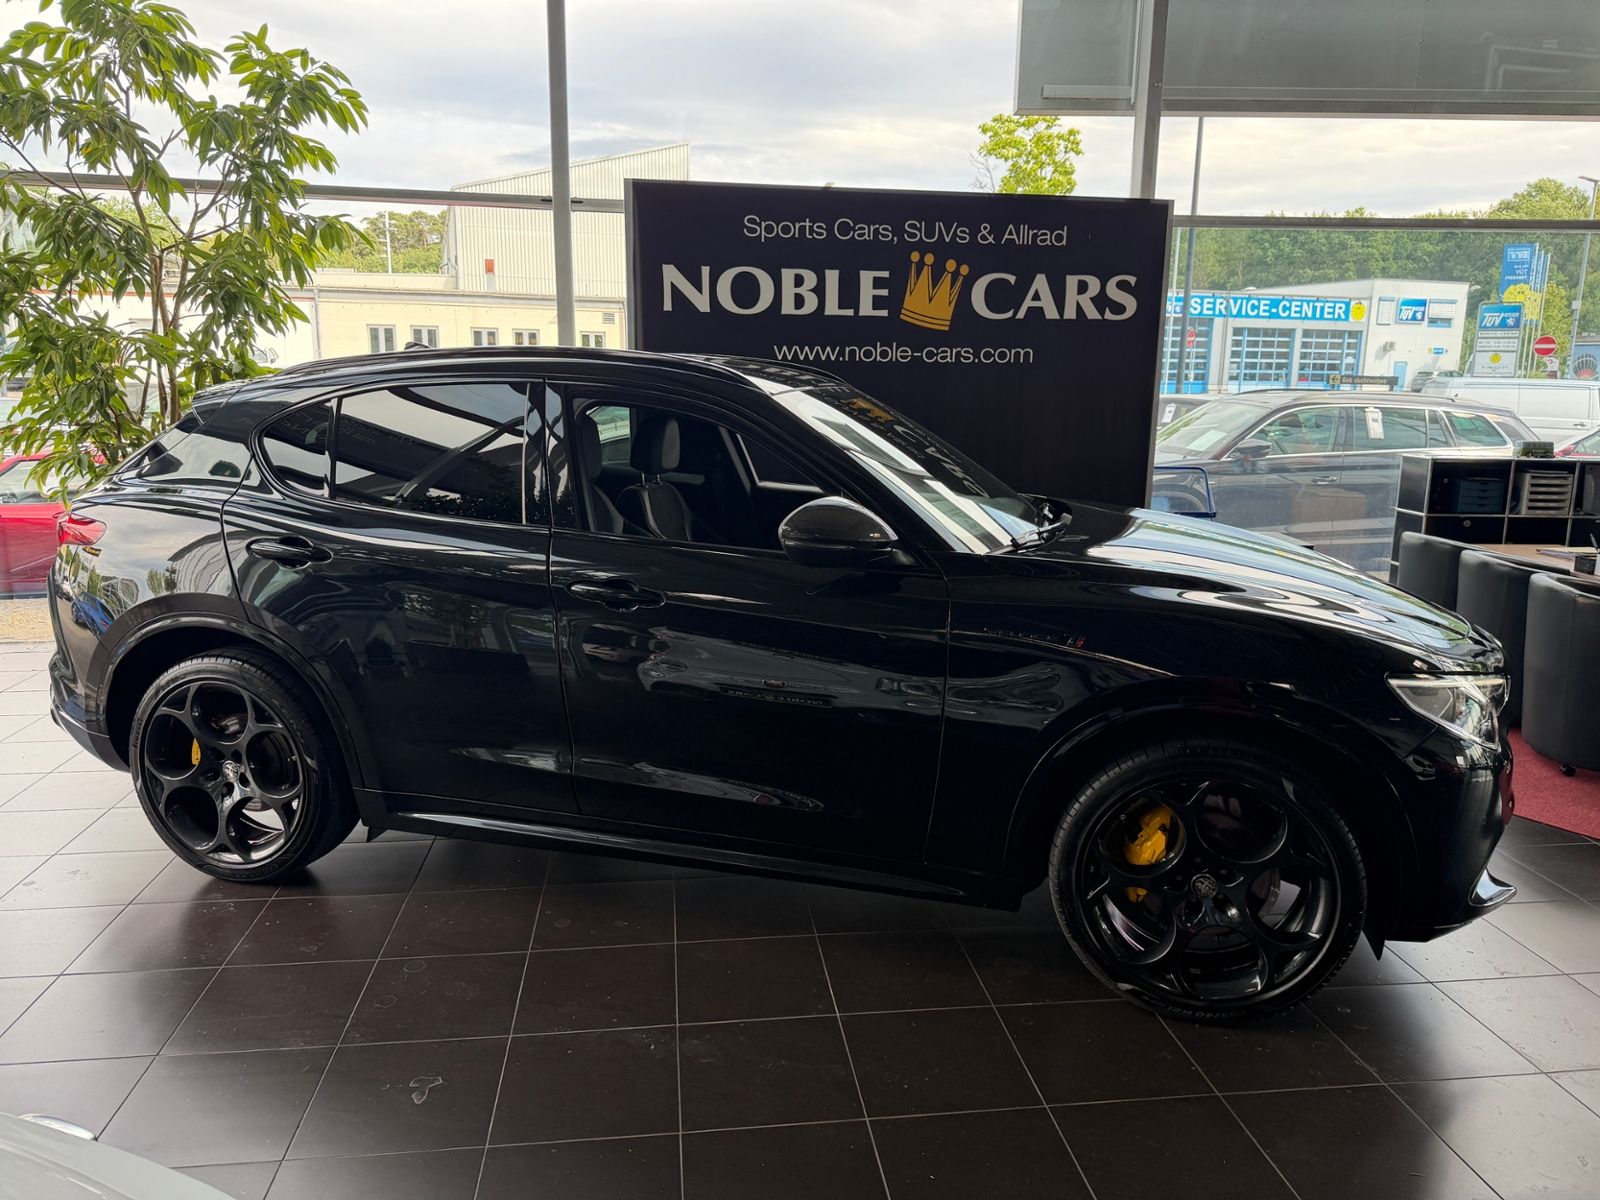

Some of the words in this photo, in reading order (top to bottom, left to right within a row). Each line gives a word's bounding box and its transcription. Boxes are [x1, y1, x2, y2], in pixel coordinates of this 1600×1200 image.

[744, 215, 826, 242] Sports
[835, 219, 897, 244] Cars,
[904, 221, 969, 243] SUVs
[978, 224, 995, 244] &
[1002, 225, 1067, 245] Allrad
[662, 264, 889, 316] NOBLE
[971, 273, 1137, 320] CARS
[1189, 297, 1346, 320] SERVICE-CENTER
[773, 342, 1034, 363] www.noble-cars.com
